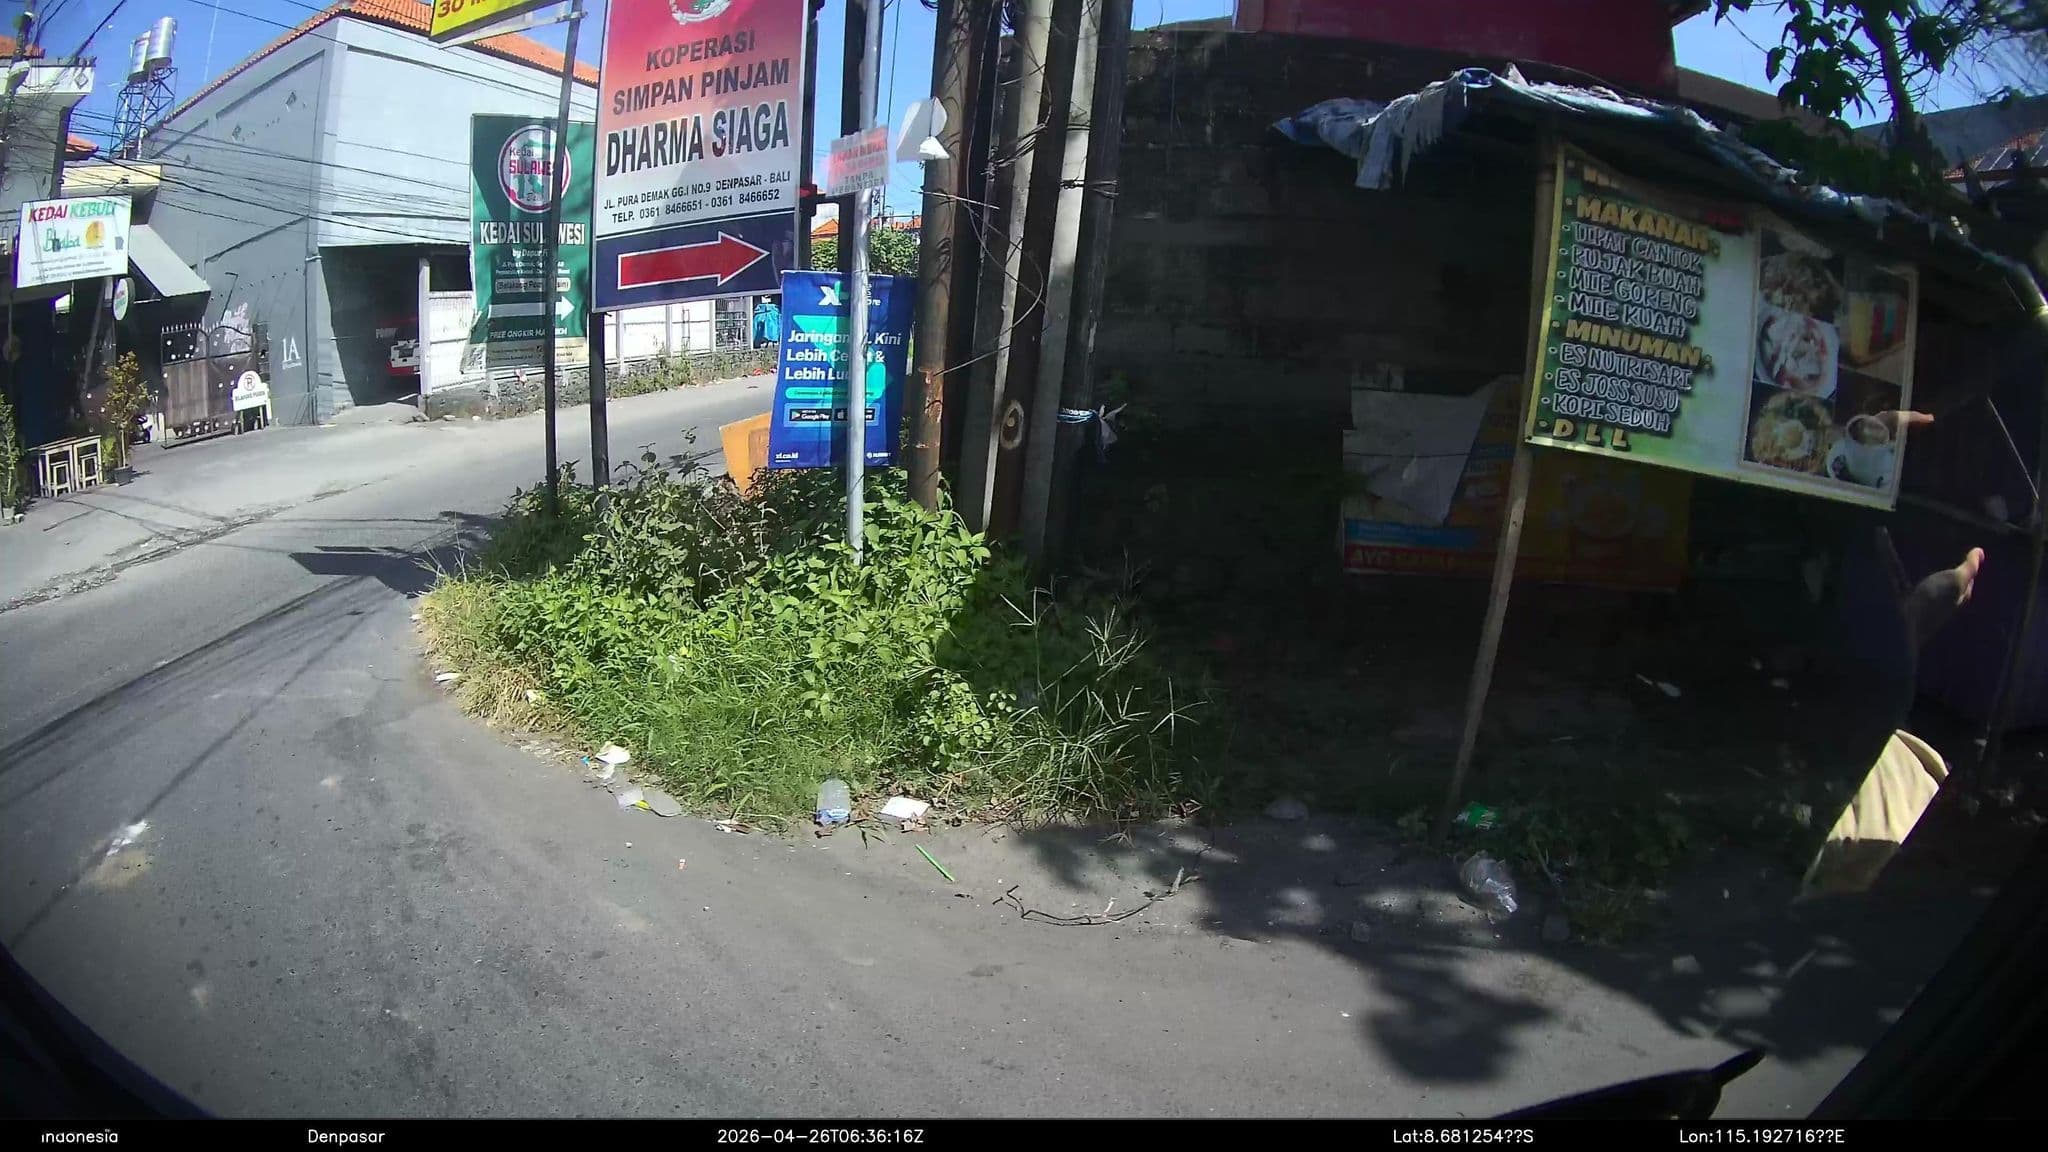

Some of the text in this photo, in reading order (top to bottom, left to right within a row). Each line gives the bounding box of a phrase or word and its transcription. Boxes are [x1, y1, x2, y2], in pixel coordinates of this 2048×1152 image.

[646, 30, 756, 72] KOPERASI
[613, 58, 790, 115] SIMPAN PINJAM
[606, 115, 704, 177] DHARMA
[712, 101, 790, 158] SIAGA
[612, 212, 635, 224] TELP.
[639, 207, 660, 219] 0361
[665, 200, 702, 215] 8466651
[711, 196, 733, 208] 0361
[739, 188, 780, 205] 8466652
[617, 196, 639, 207] PURA
[641, 190, 669, 203] DEMAK
[692, 183, 711, 195] NO.9
[716, 174, 762, 191] DENPASAR
[769, 171, 790, 183] BALI
[28, 204, 68, 223] KEDAI
[480, 221, 520, 244] KEDAI
[1570, 243, 1702, 298] RUJAK BUAH
[1614, 278, 1700, 320] GORENG
[788, 330, 849, 345] Jaringan
[875, 333, 901, 345] Kini
[1621, 303, 1689, 339] KUAH
[786, 349, 827, 361] Lebih
[875, 350, 885, 362] &
[1559, 342, 1588, 368] ES
[785, 367, 825, 380] Lebih
[1554, 367, 1681, 414] ES JOSS SUSU
[1552, 392, 1673, 433] KOPI SEDUH
